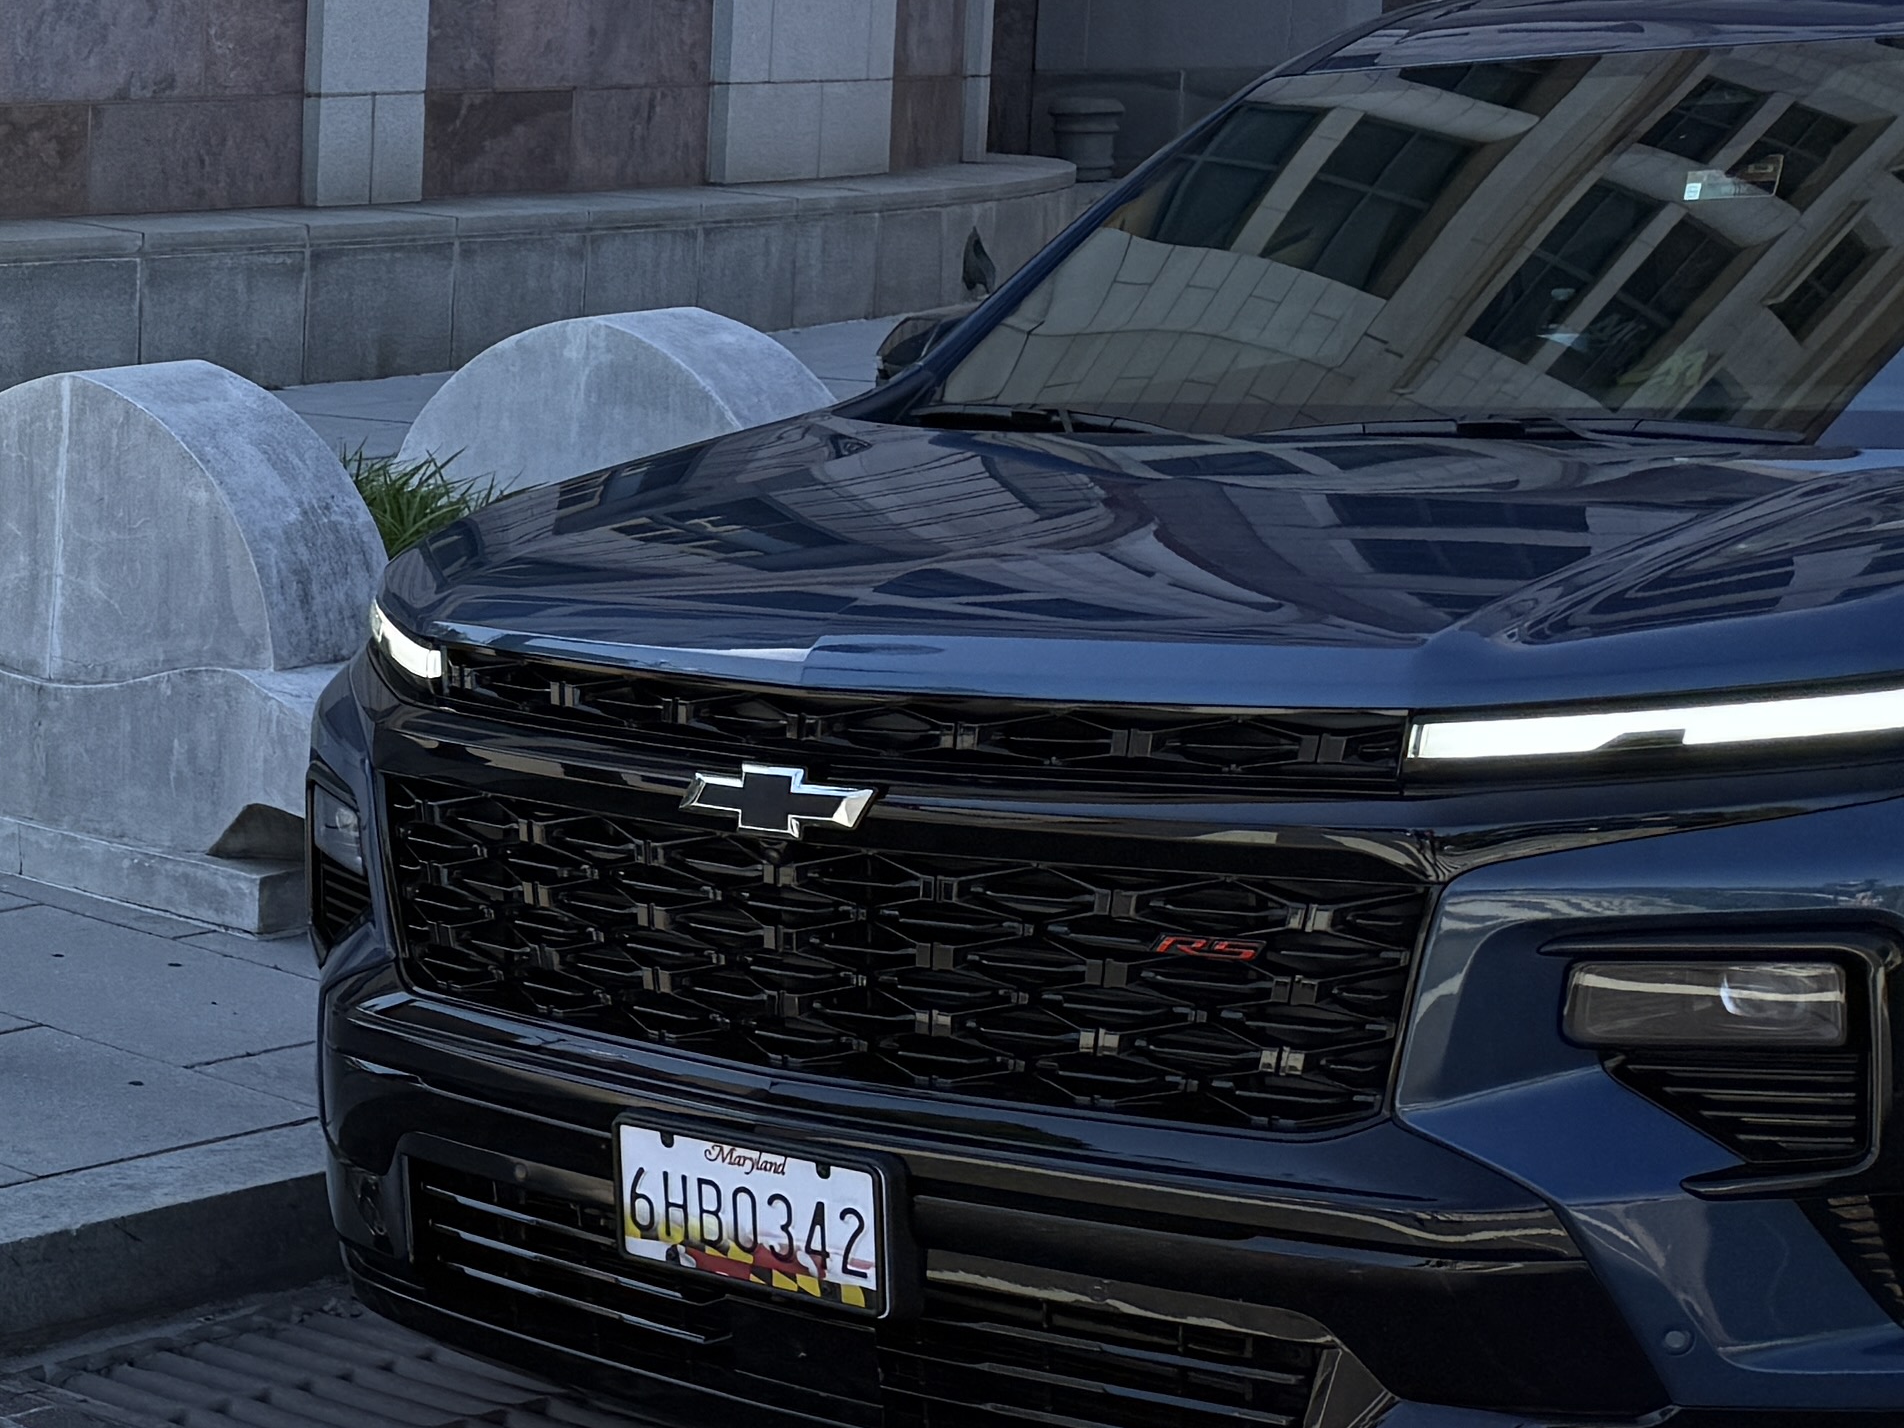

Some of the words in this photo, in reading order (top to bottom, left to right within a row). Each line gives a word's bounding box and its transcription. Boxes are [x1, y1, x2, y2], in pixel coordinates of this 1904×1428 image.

[1156, 935, 1259, 961] RS
[704, 1144, 789, 1176] Maryland
[630, 1167, 868, 1279] 6HB0342
